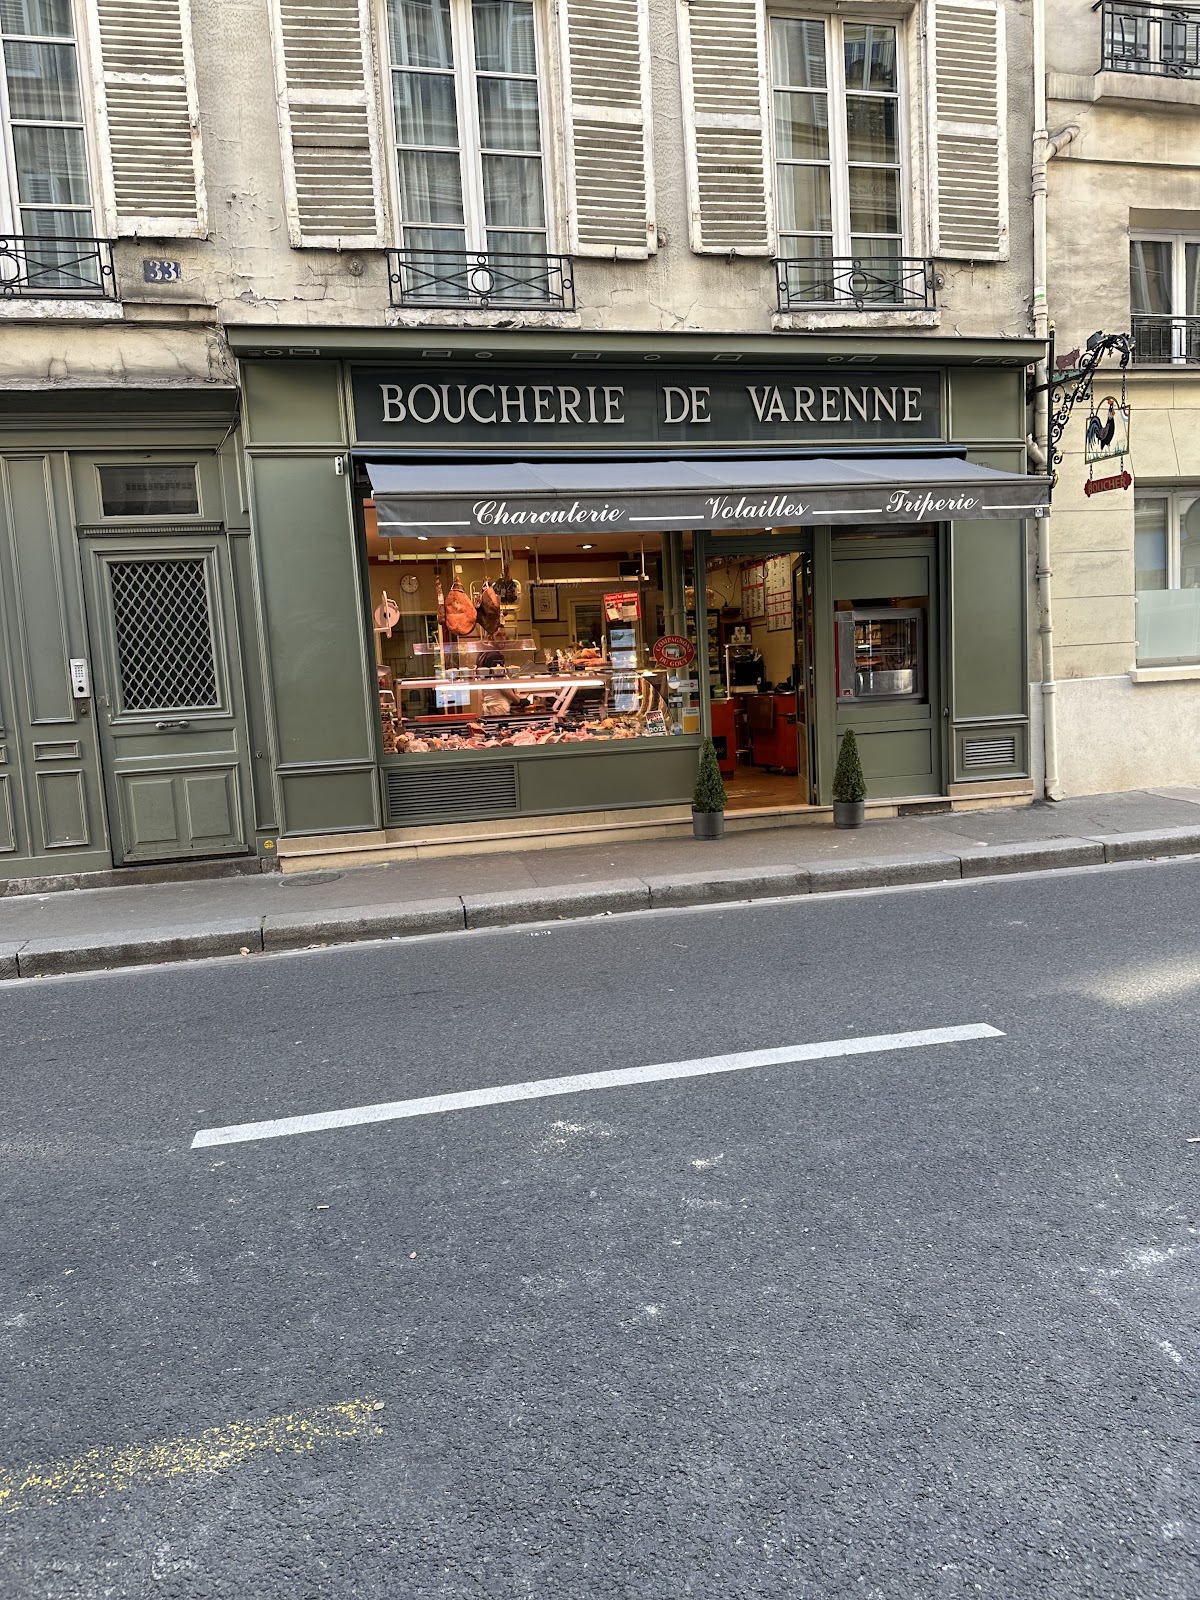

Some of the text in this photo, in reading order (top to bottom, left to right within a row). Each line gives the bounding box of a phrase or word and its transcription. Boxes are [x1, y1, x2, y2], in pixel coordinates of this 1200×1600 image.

[150, 260, 177, 280] 33
[379, 383, 922, 424] BOUCHERIE DE VARENNE
[1088, 477, 1126, 494] BOUCHER
[472, 490, 979, 525] Charcuterie Volailles Triperie
[656, 637, 692, 652] COMPAGNONS
[660, 656, 669, 665] DU
